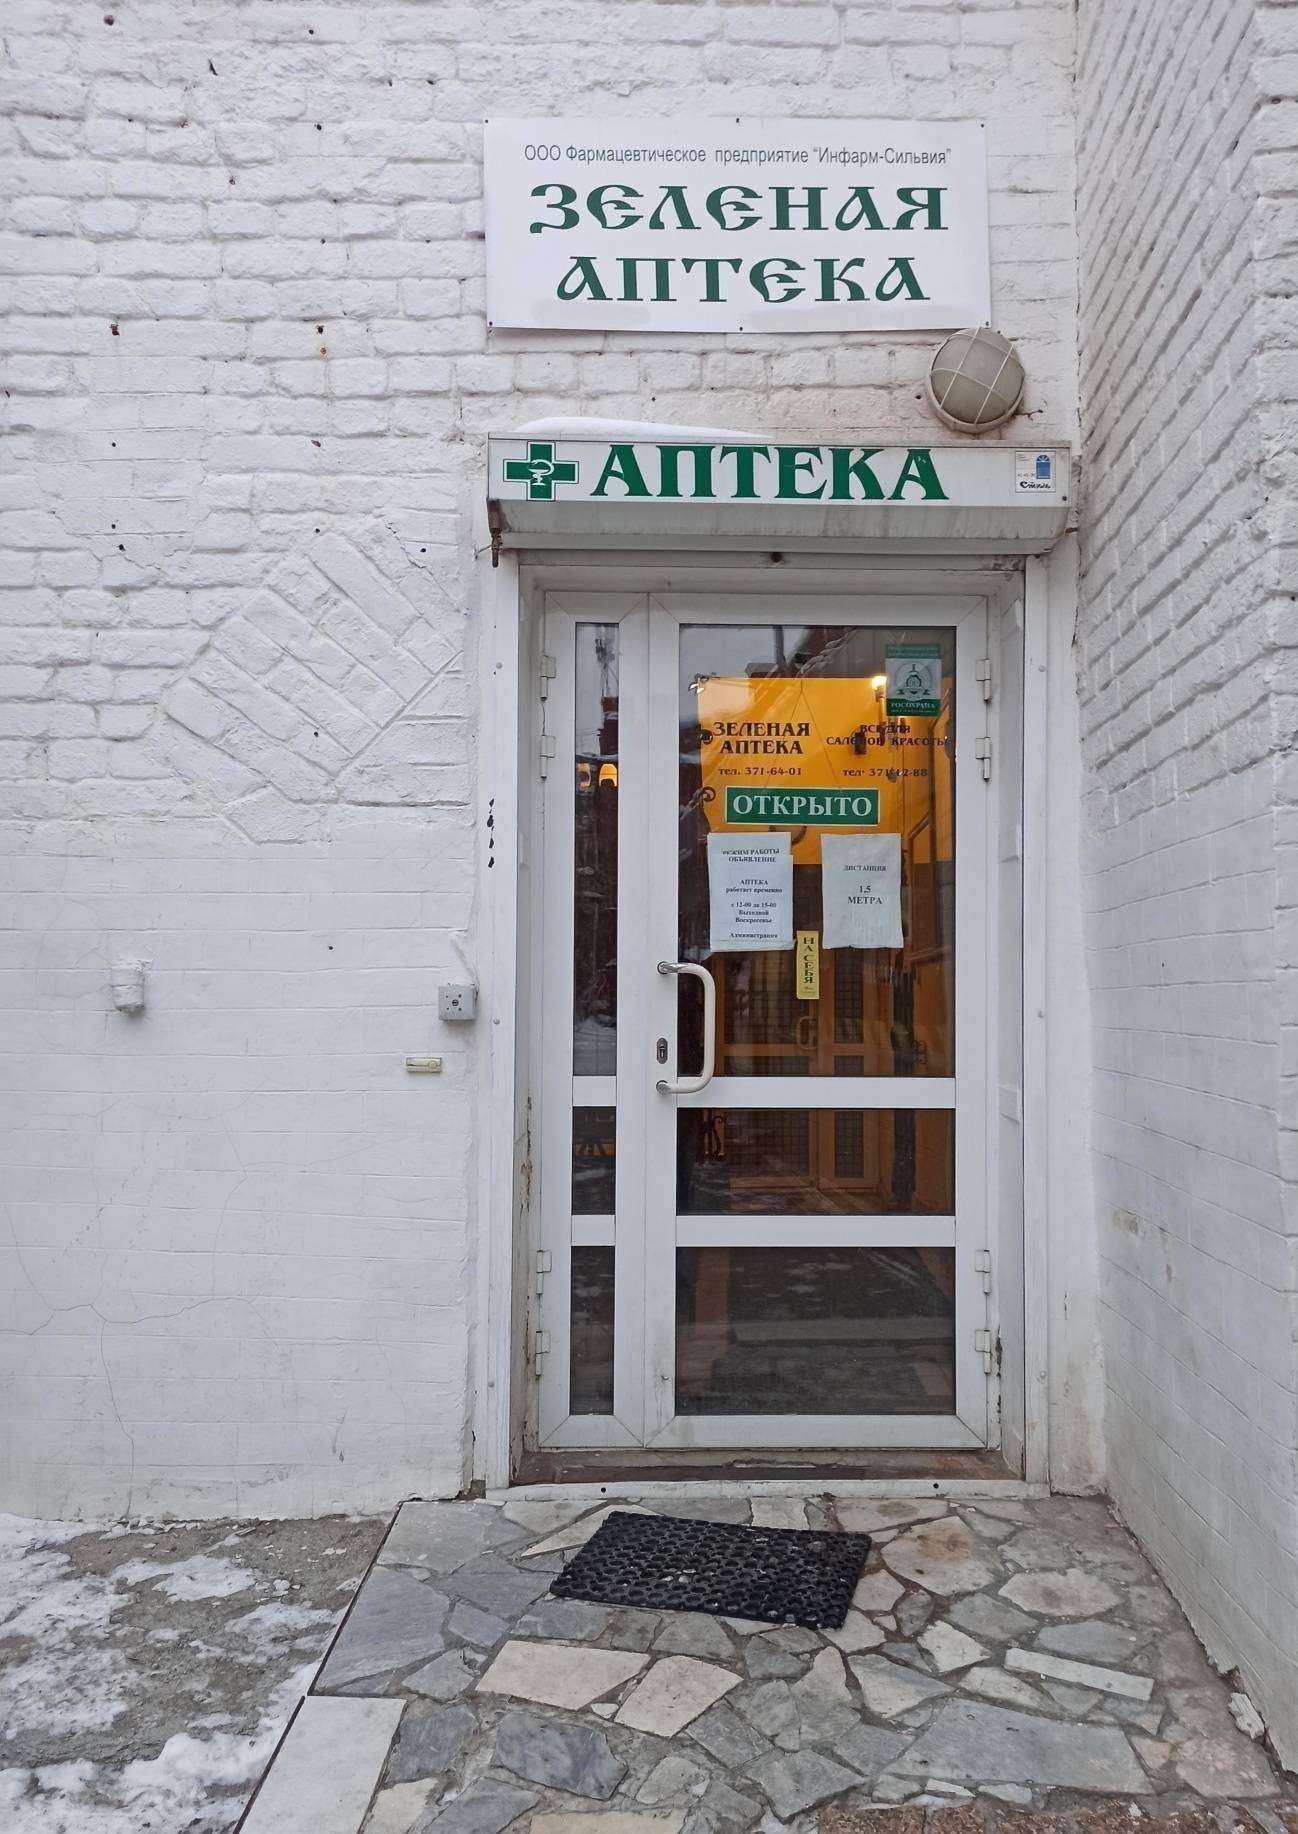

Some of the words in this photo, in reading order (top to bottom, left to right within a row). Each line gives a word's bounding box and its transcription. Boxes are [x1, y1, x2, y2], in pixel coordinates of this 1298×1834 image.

[524, 144, 561, 161] ООО
[566, 144, 706, 164] Фармацевтическое
[715, 147, 809, 167] предприятие
[530, 183, 949, 234] ЗЕЛЕНАЯ
[556, 256, 931, 303] АПТЕКА
[590, 444, 949, 501] АПТЕКА
[713, 721, 811, 737] ЗЕЛЕНАЯ
[719, 740, 804, 755] АПТЕКА
[745, 766, 802, 776] 371-64-01
[868, 768, 928, 778] 37112-88
[732, 794, 872, 817] ОТКРЫТО
[848, 896, 883, 905] МЕТРА
[803, 937, 815, 952] НА
